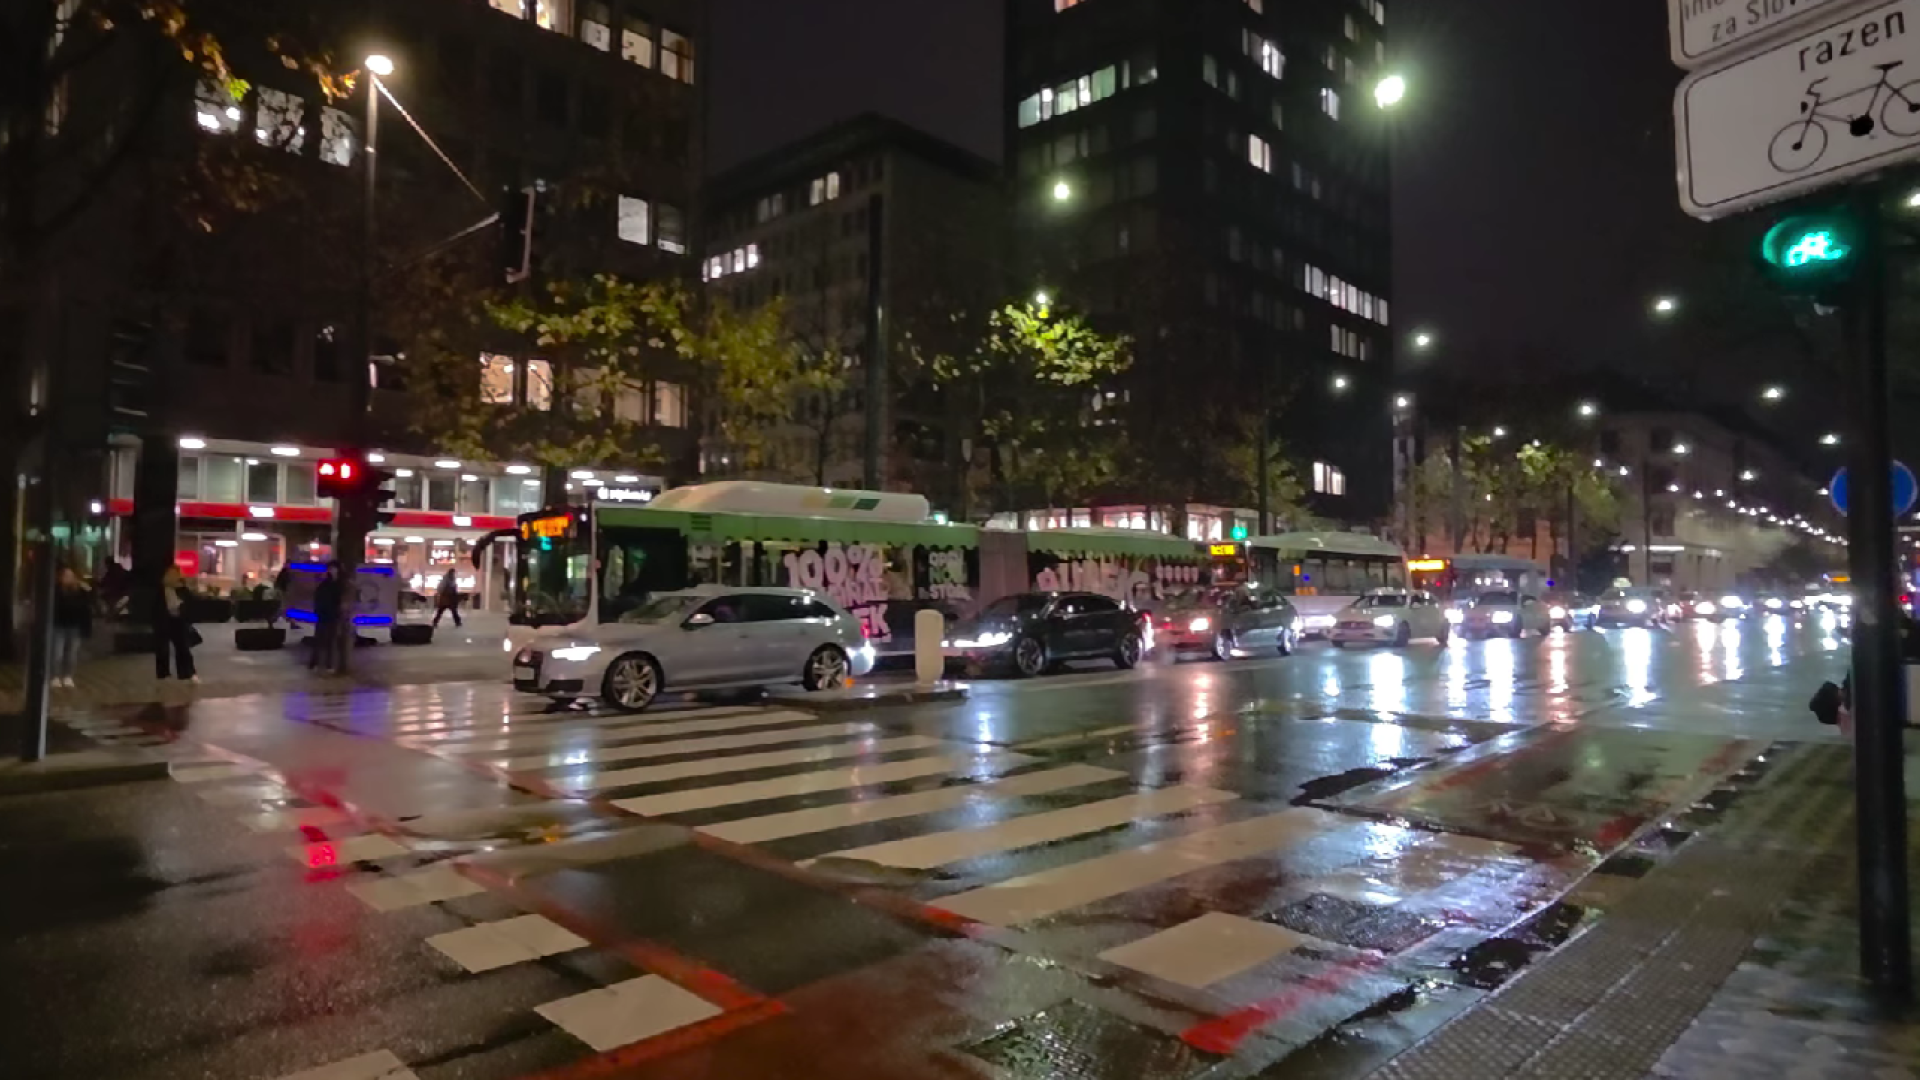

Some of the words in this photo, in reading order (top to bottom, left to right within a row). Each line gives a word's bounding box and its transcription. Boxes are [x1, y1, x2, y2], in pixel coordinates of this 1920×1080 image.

[1712, 16, 1736, 42] za
[1798, 11, 1905, 71] razen
[784, 545, 884, 590] 100%
